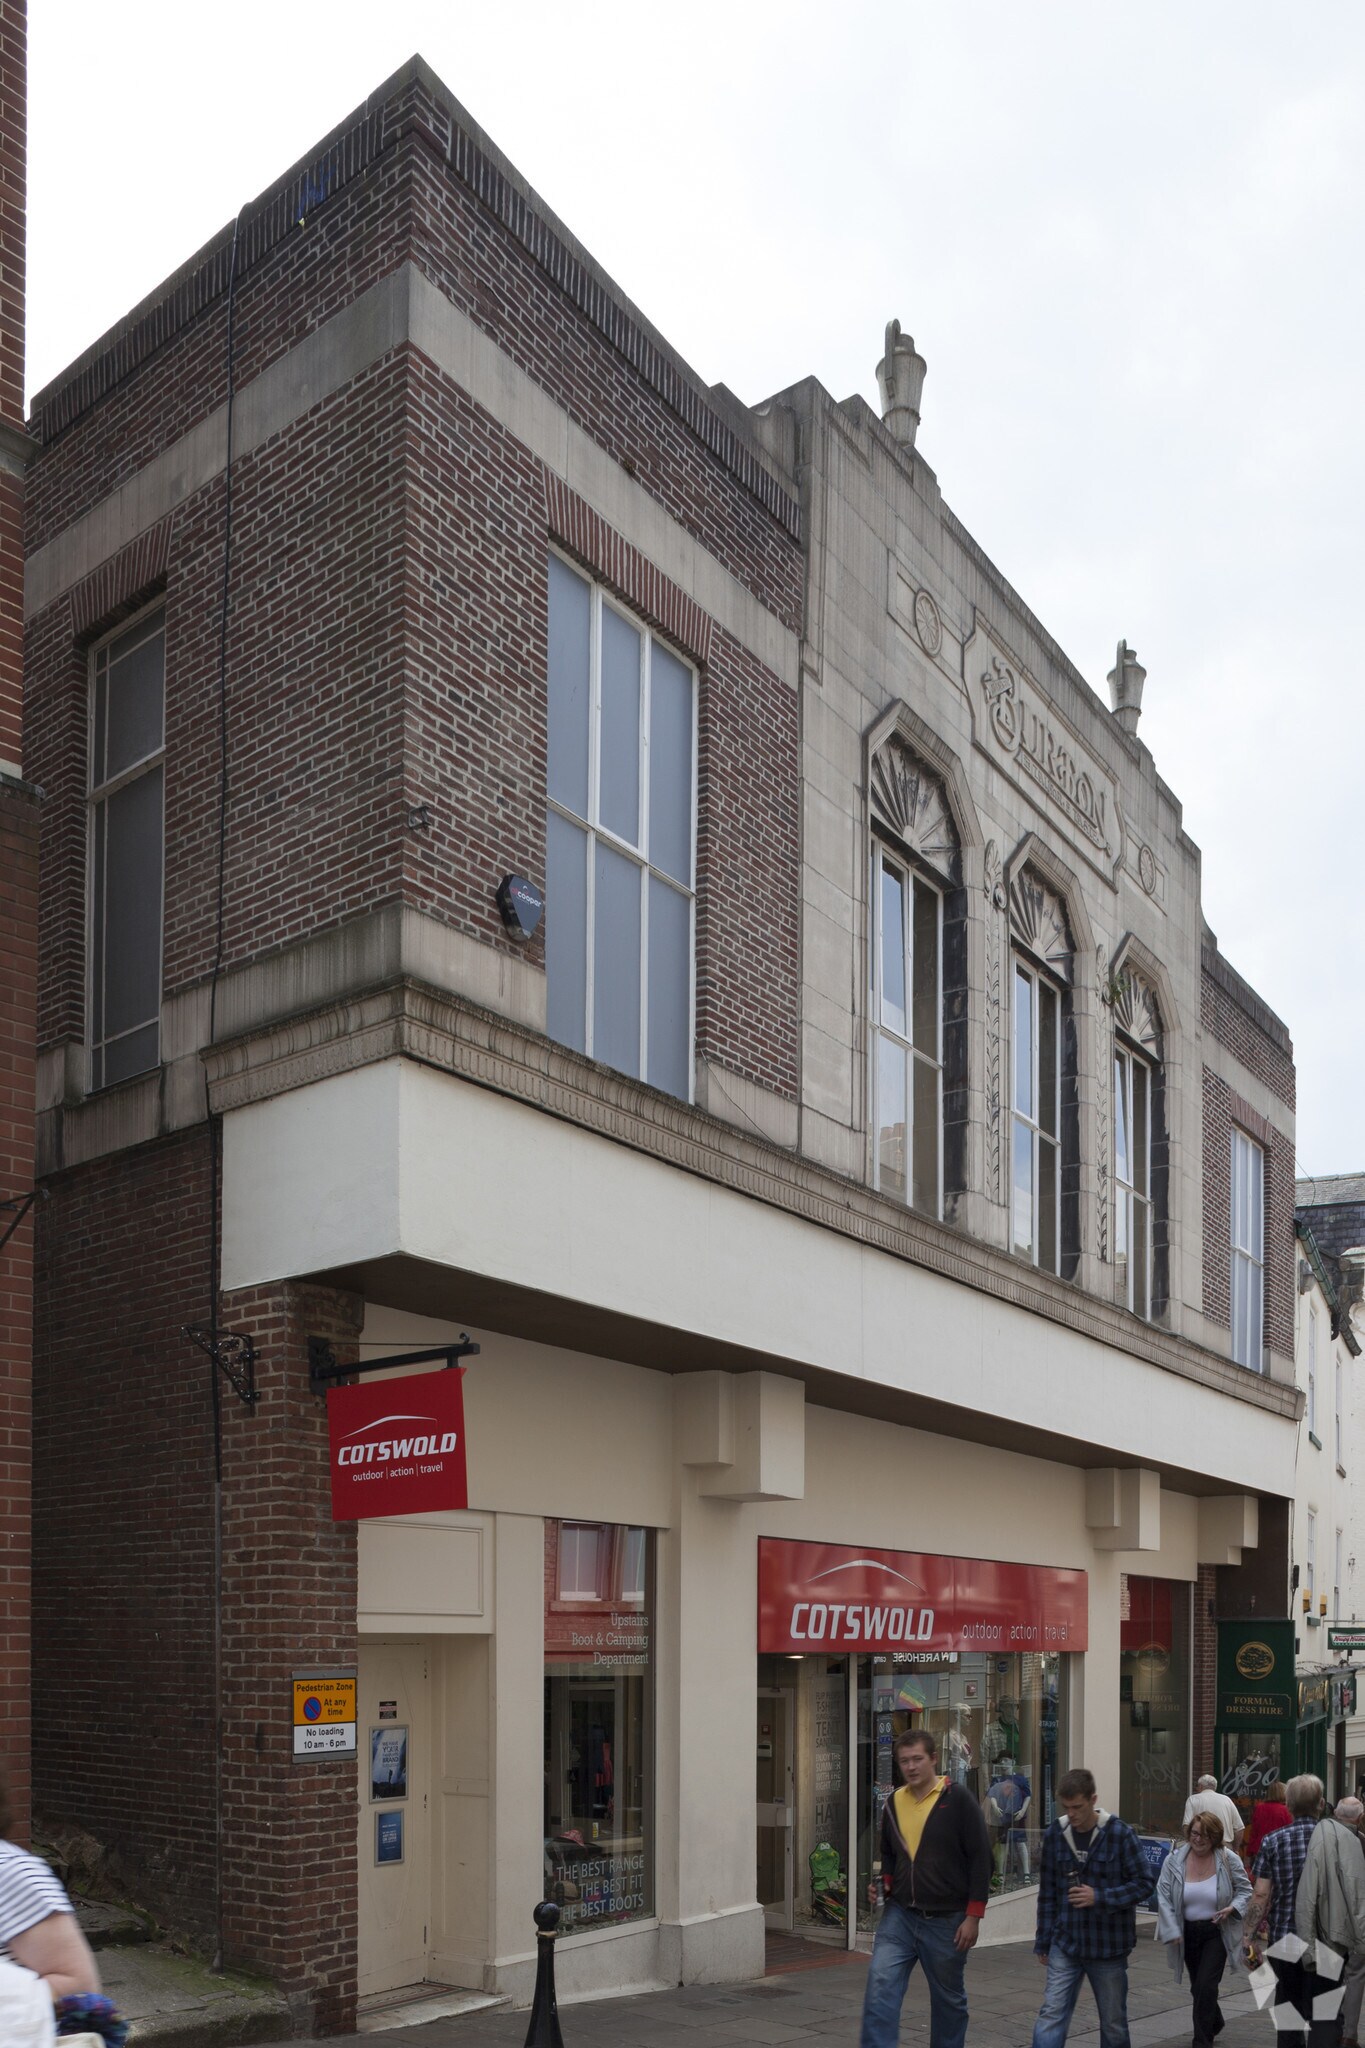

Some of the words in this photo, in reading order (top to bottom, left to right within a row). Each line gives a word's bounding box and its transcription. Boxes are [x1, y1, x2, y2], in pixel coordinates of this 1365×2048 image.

[337, 1432, 457, 1466] COTSWOLD
[352, 1470, 384, 1482] outdoor
[390, 1465, 414, 1477] action
[420, 1461, 443, 1474] travel
[611, 1613, 649, 1629] Upstairs
[790, 1603, 935, 1641] COTSWOLD
[962, 1620, 1003, 1640] outdoor
[1010, 1623, 1038, 1640] action
[1045, 1620, 1069, 1640] travel
[571, 1632, 594, 1646] Boot
[596, 1632, 603, 1645] &
[605, 1631, 649, 1649] Camping
[593, 1651, 649, 1668] Department
[296, 1683, 334, 1692] Pedestrian
[324, 1698, 332, 1706] At
[334, 1699, 347, 1707] any
[1234, 1696, 1275, 1706] FORMAL
[327, 1708, 343, 1716] time
[1226, 1705, 1257, 1714] DRESS
[1259, 1706, 1283, 1715] HIRE
[306, 1728, 317, 1736] No
[318, 1727, 345, 1736] loading
[304, 1740, 313, 1749] 10
[329, 1739, 335, 1747] 6
[335, 1740, 347, 1748] pm
[1221, 1756, 1280, 1795] 1860
[556, 1864, 578, 1881] THE
[581, 1860, 606, 1878] BEST
[609, 1855, 645, 1873] RANGE
[579, 1881, 600, 1898] THE
[603, 1876, 627, 1894] BEST
[630, 1874, 644, 1889] FIT
[581, 1900, 606, 1918] BEST
[609, 1893, 644, 1913] BOOTS
